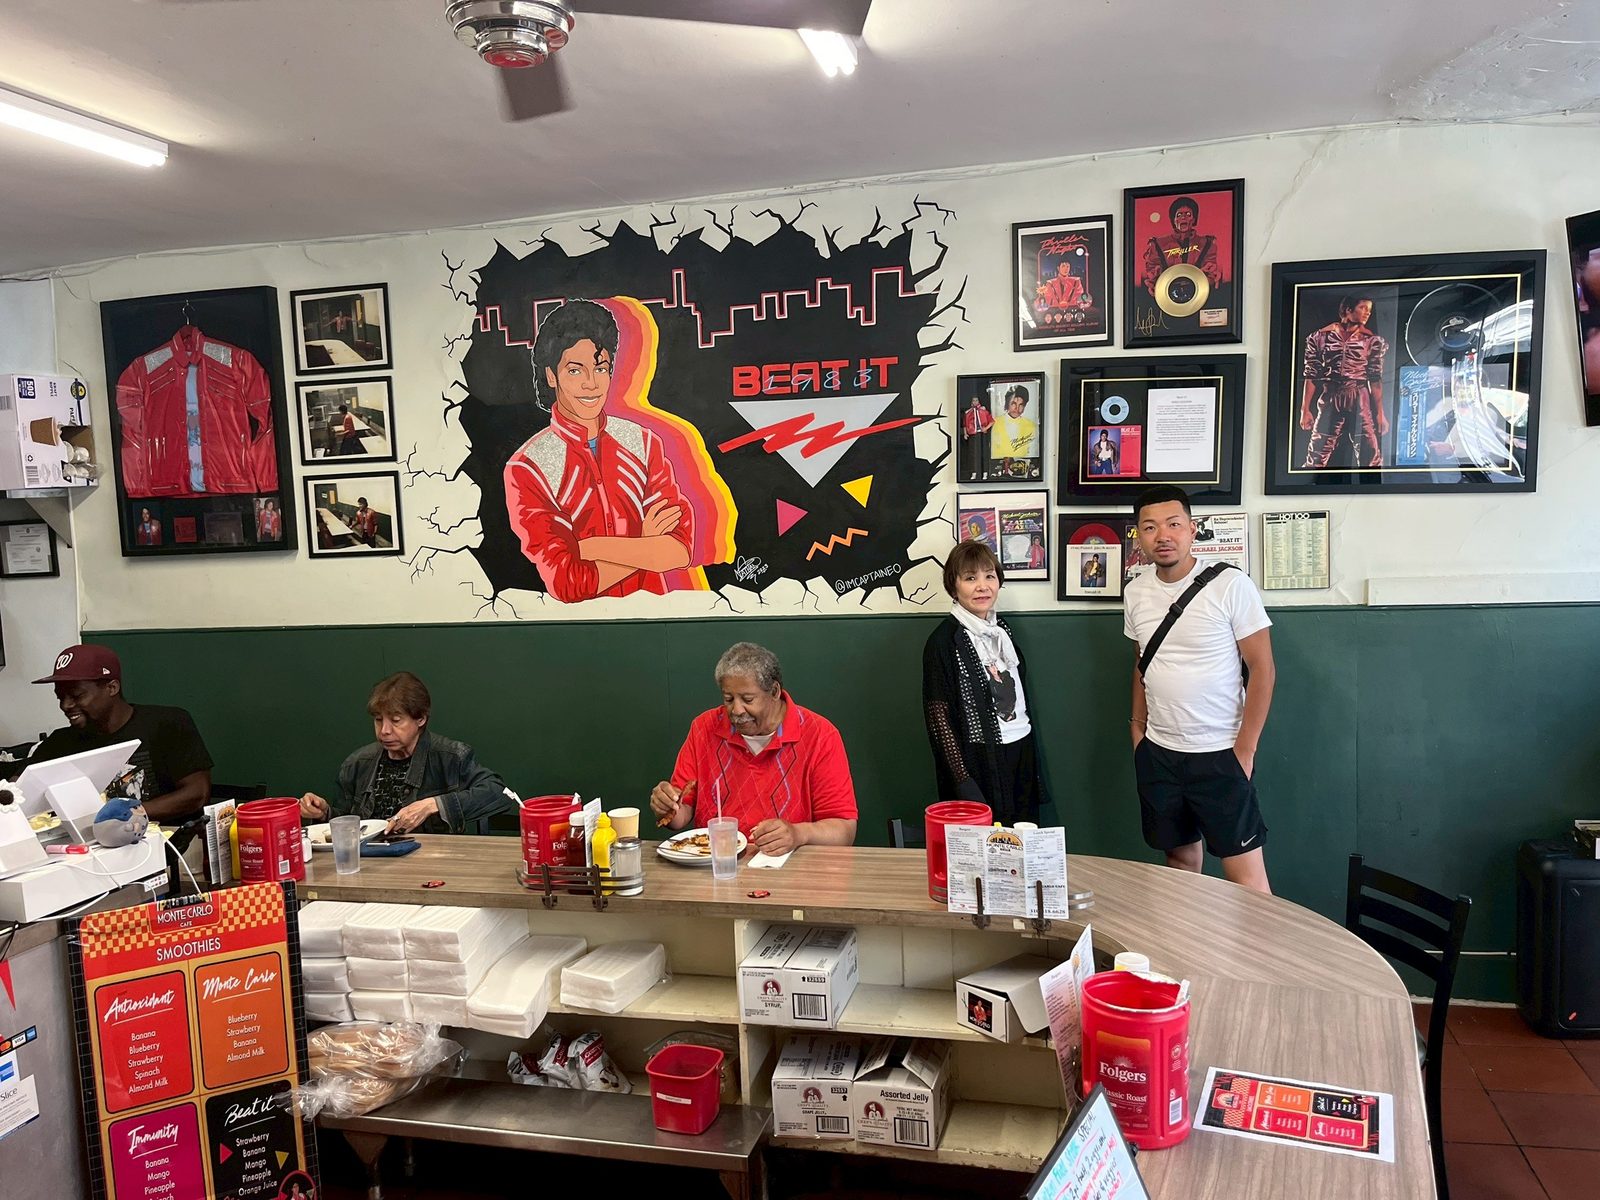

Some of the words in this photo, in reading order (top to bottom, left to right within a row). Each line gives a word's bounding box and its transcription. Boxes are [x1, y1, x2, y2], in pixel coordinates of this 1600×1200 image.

[732, 359, 849, 397] BEAT
[859, 356, 899, 389] IT
[26, 380, 34, 397] 500
[1294, 512, 1310, 520] 100
[835, 563, 901, 593] @IMCAPTAINEO
[56, 652, 74, 670] W
[240, 843, 263, 853] Folgers
[157, 908, 187, 924] MONTE
[187, 903, 213, 919] CARLO
[180, 920, 193, 928] CAFE
[156, 937, 221, 961] SMOOTHIES
[203, 976, 241, 1000] Monte
[244, 967, 278, 991] Carlo
[103, 989, 175, 1023] Antioxidant
[227, 1012, 258, 1024] Blueberry
[131, 1030, 156, 1041] Banana
[226, 1024, 261, 1037] Strawberry
[129, 1042, 160, 1055] Blueberry
[233, 1037, 257, 1049] Banana
[128, 1054, 164, 1068] Strawberry
[226, 1050, 251, 1063] Almond
[251, 1046, 266, 1056] Milk
[134, 1066, 161, 1081] Spinach
[1100, 1062, 1147, 1082] Folgers
[128, 1082, 153, 1094] Almond
[154, 1077, 169, 1088] Milk
[880, 1089, 911, 1100] Assorted
[912, 1092, 929, 1103] Jelly
[1104, 1087, 1124, 1099] lassic
[1126, 1093, 1147, 1102] Roast
[224, 1097, 262, 1127] Beat
[261, 1095, 276, 1113] it
[127, 1123, 179, 1155] Immunity
[235, 1133, 270, 1147] Strawberry
[242, 1146, 266, 1158] Banana
[144, 1157, 170, 1169] Banana
[244, 1159, 267, 1170] Mango
[147, 1170, 170, 1181] Mango
[242, 1168, 272, 1183] Pineapple
[144, 1180, 176, 1195] Pineapple
[238, 1185, 262, 1196] Orange
[262, 1180, 278, 1190] Juice
